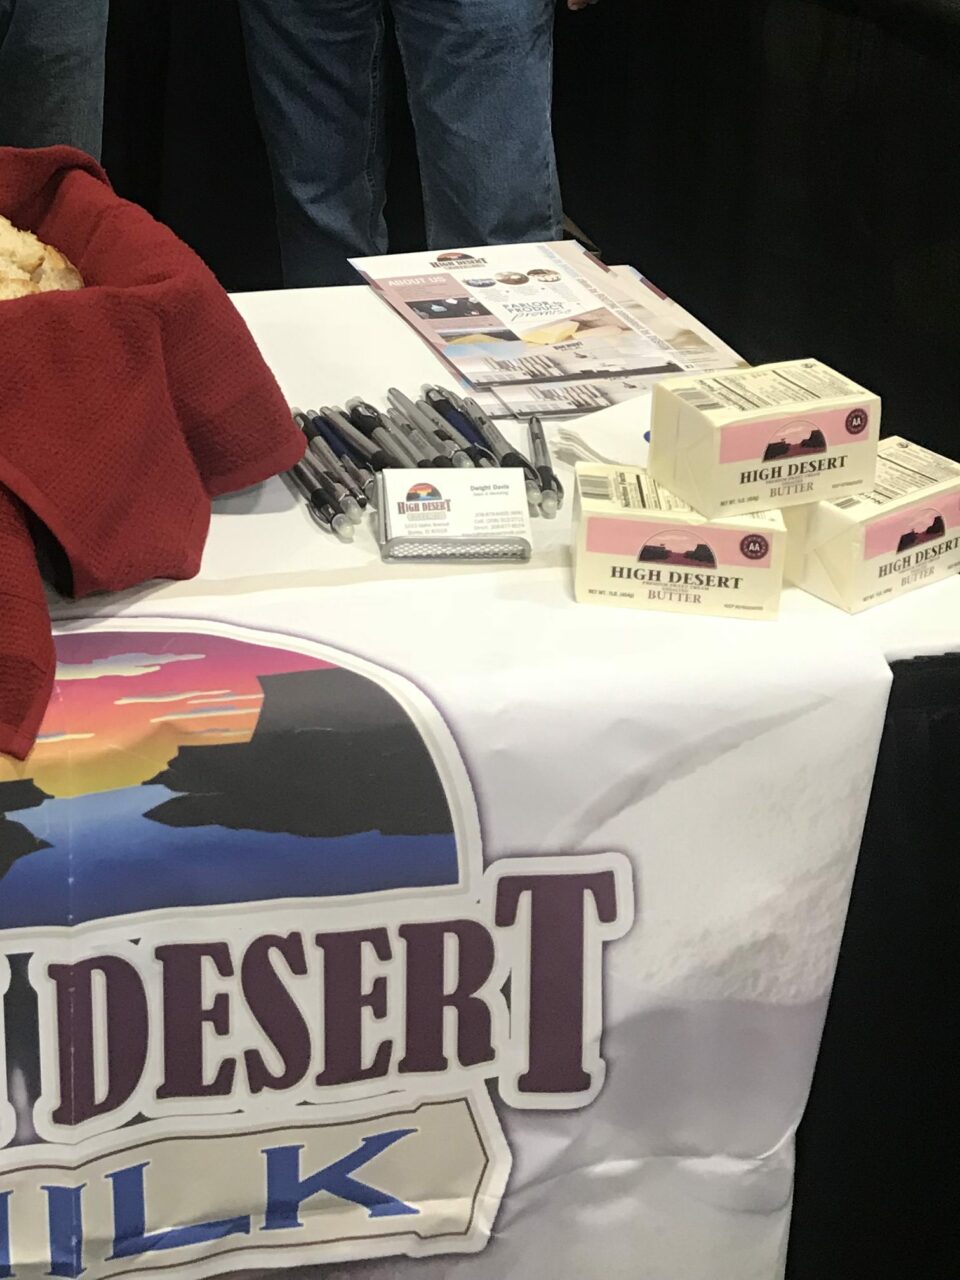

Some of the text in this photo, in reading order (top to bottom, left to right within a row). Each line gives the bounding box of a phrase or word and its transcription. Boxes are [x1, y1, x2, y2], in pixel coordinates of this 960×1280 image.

[388, 275, 447, 287] ABOUT US
[852, 417, 861, 426] AA
[740, 455, 848, 485] HIGH DESERT
[769, 482, 814, 498] BUTTER
[397, 499, 451, 514] HIGH DESERT
[749, 542, 761, 551] AA
[878, 537, 960, 578] HIGH DESERT
[610, 566, 744, 590] HIGH DESERT
[647, 589, 702, 604] BUTTER
[46, 870, 619, 1126] DESERT
